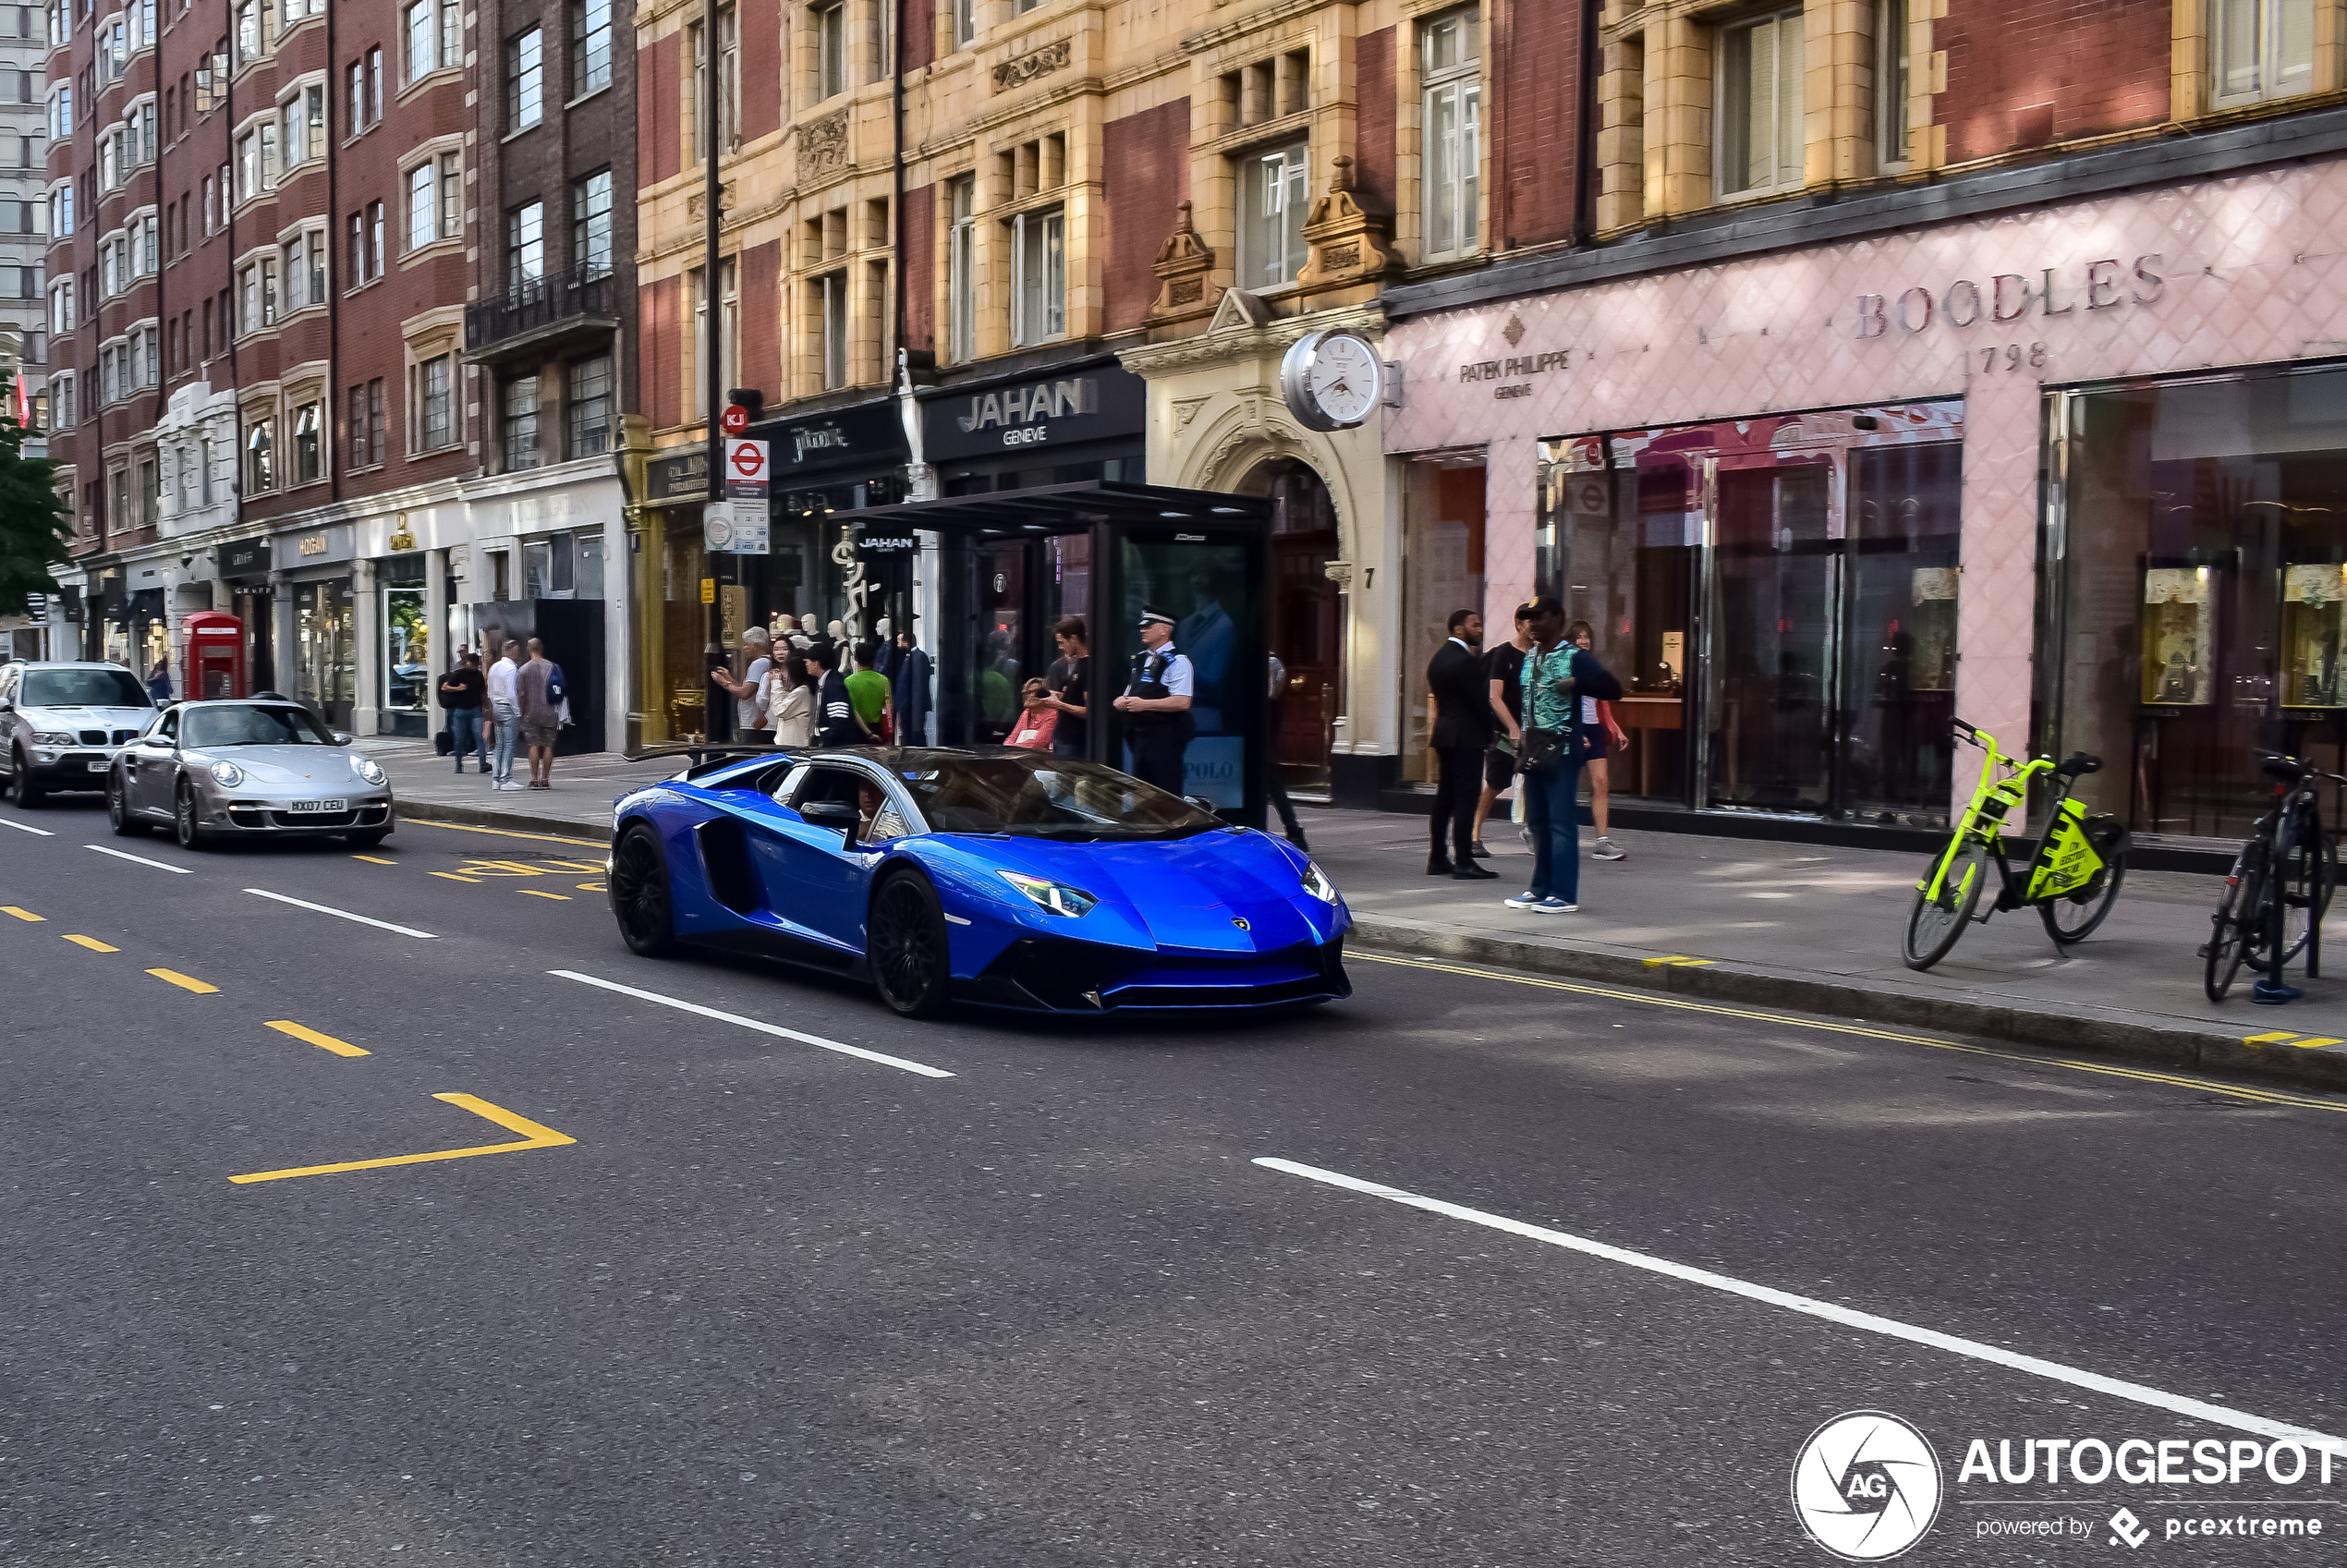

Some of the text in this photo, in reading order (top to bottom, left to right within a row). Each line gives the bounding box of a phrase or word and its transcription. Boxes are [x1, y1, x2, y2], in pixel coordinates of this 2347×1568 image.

[1855, 252, 2164, 340] BOODLES
[1460, 350, 1569, 383] PATEK PHILIPPE
[1961, 341, 2048, 376] 1798
[1493, 383, 1533, 399] GENEVE
[956, 378, 1087, 432] JAHAN
[1003, 426, 1047, 445] GENEVE
[858, 538, 913, 548] JAHAN
[1364, 567, 1375, 590] 7
[1183, 761, 1234, 779] POLO
